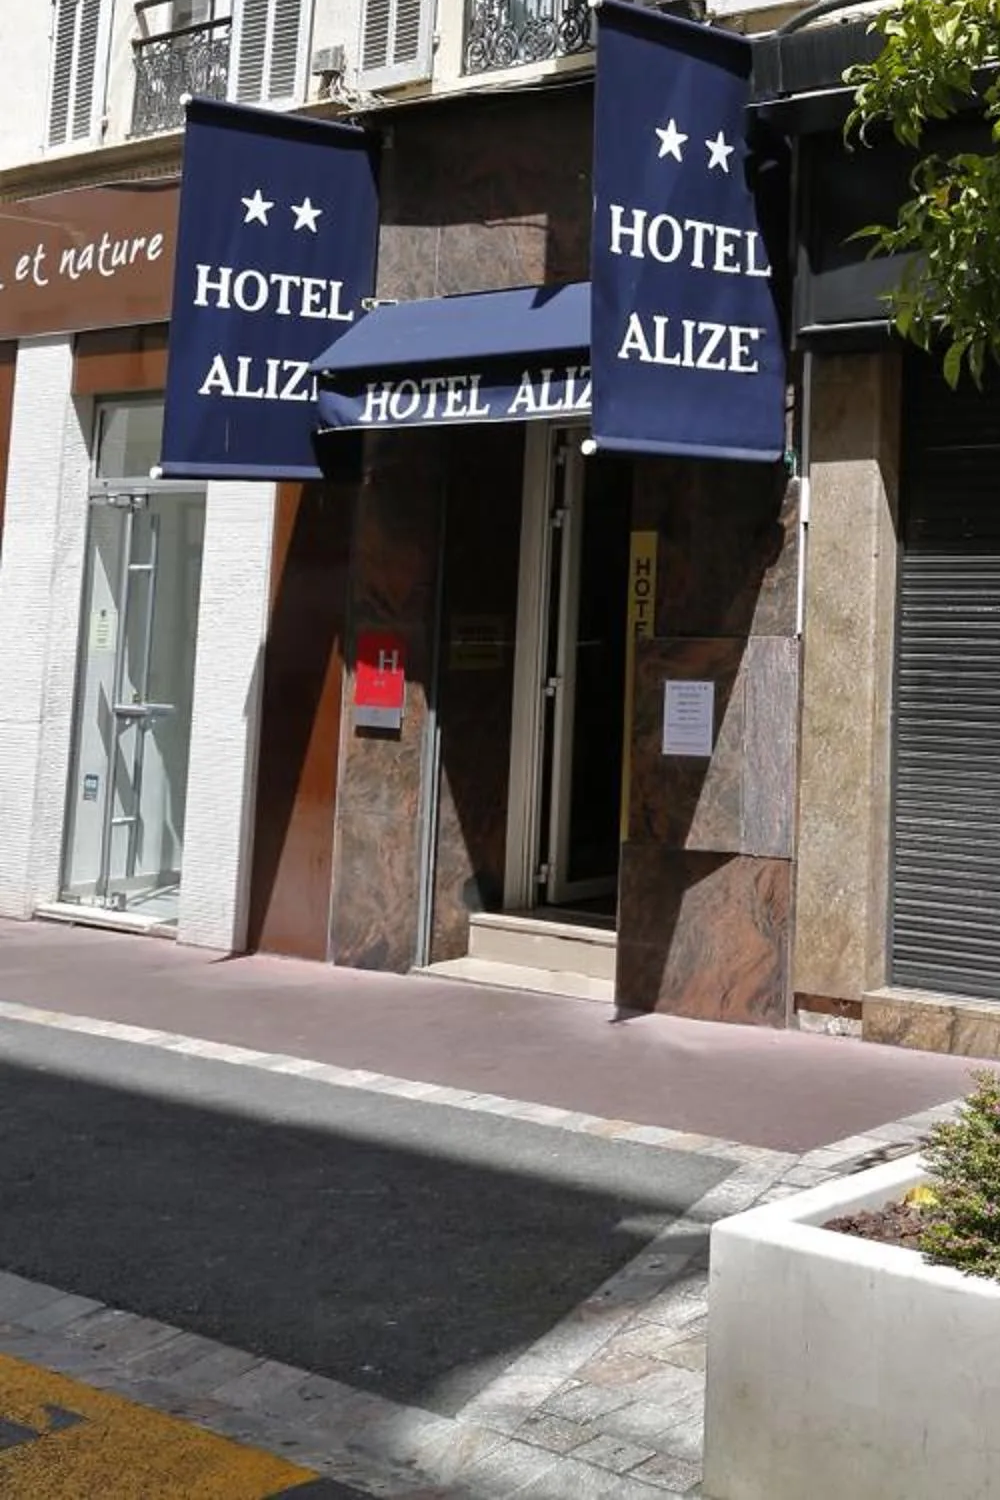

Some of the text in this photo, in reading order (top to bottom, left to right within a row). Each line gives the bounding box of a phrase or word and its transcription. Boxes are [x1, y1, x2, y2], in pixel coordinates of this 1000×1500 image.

[15, 232, 164, 286] et nature
[610, 204, 772, 276] HOTEL
[193, 264, 354, 321] HOTEL
[617, 311, 762, 373] ALIZE
[198, 352, 319, 402] ALIZ
[358, 365, 592, 422] HOTEL ALIZ
[633, 557, 652, 636] HOTE
[379, 650, 399, 675] H
